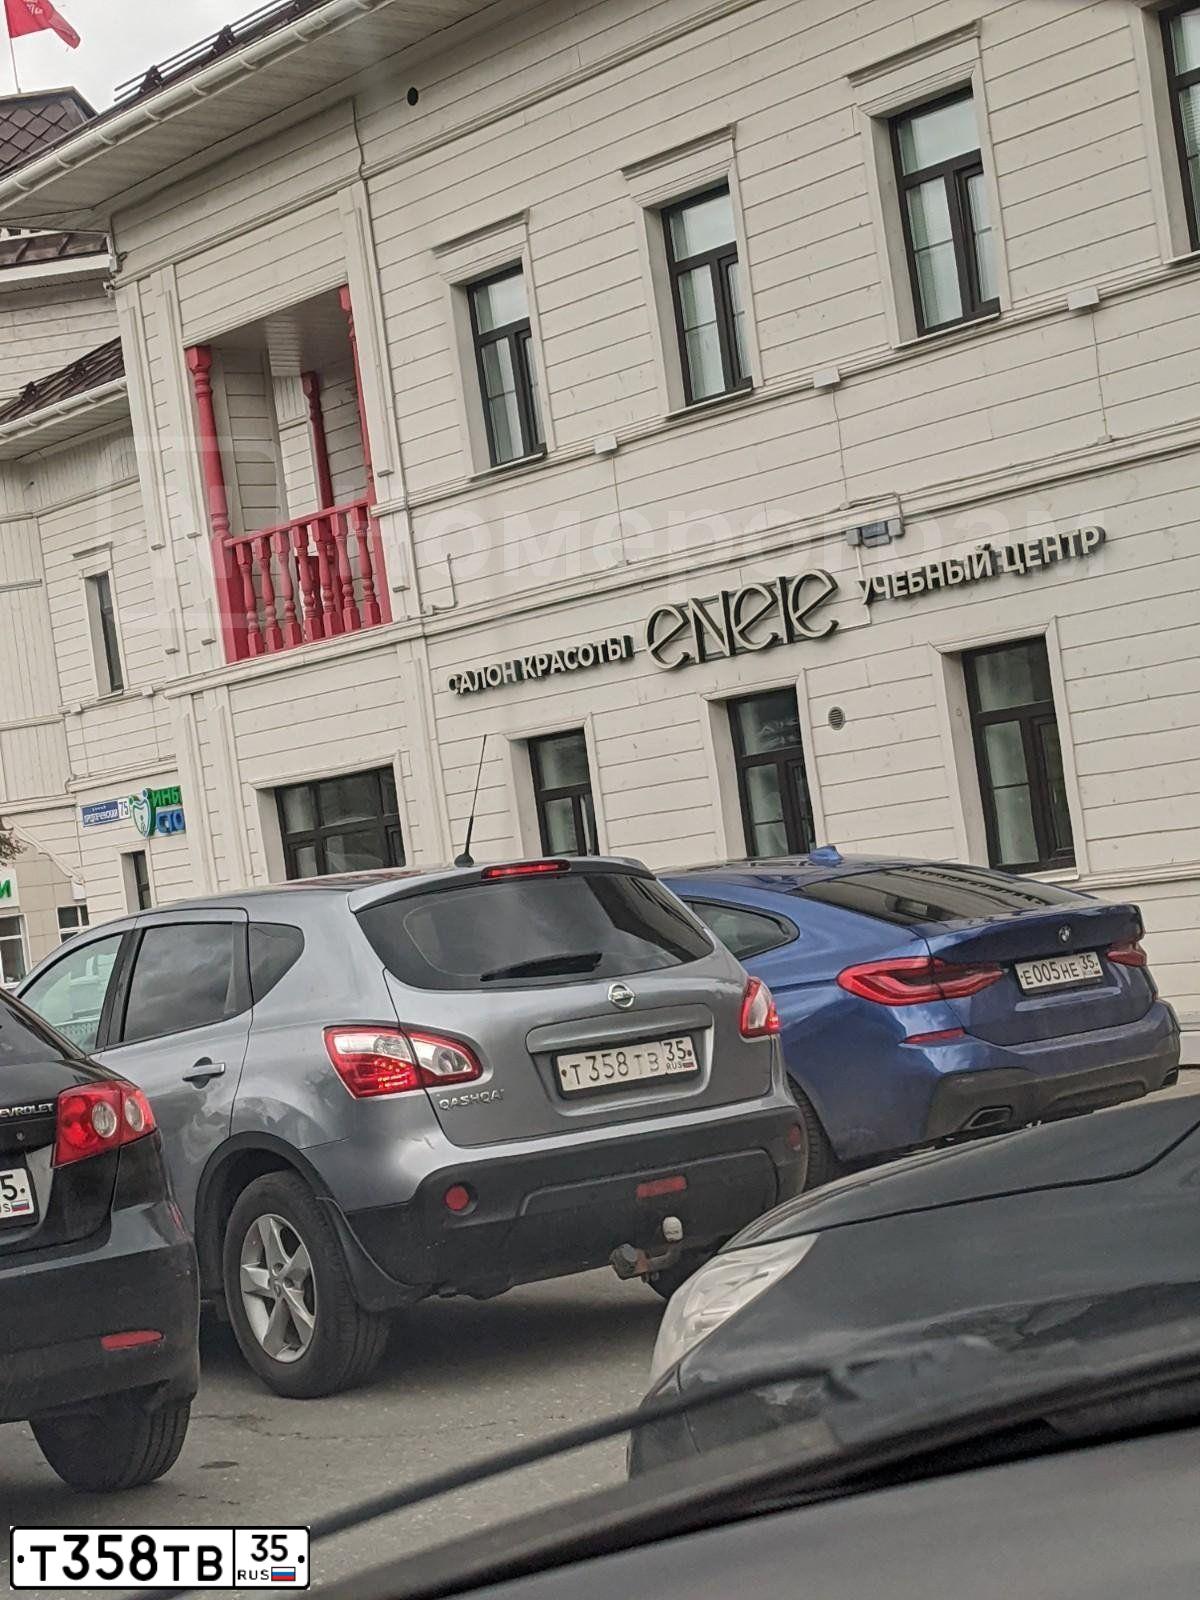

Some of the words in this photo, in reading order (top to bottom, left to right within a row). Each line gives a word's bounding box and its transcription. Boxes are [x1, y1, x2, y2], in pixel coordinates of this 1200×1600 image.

[858, 542, 993, 604] УЧЕБНЫЙ
[999, 525, 1105, 575] ЦЕНТР
[447, 657, 519, 695] САЛОН
[520, 634, 633, 680] КРАСОТЫ
[118, 800, 129, 818] 75
[1079, 954, 1095, 971] 35
[663, 1040, 687, 1062] 35
[438, 1088, 505, 1110] QASHQA
